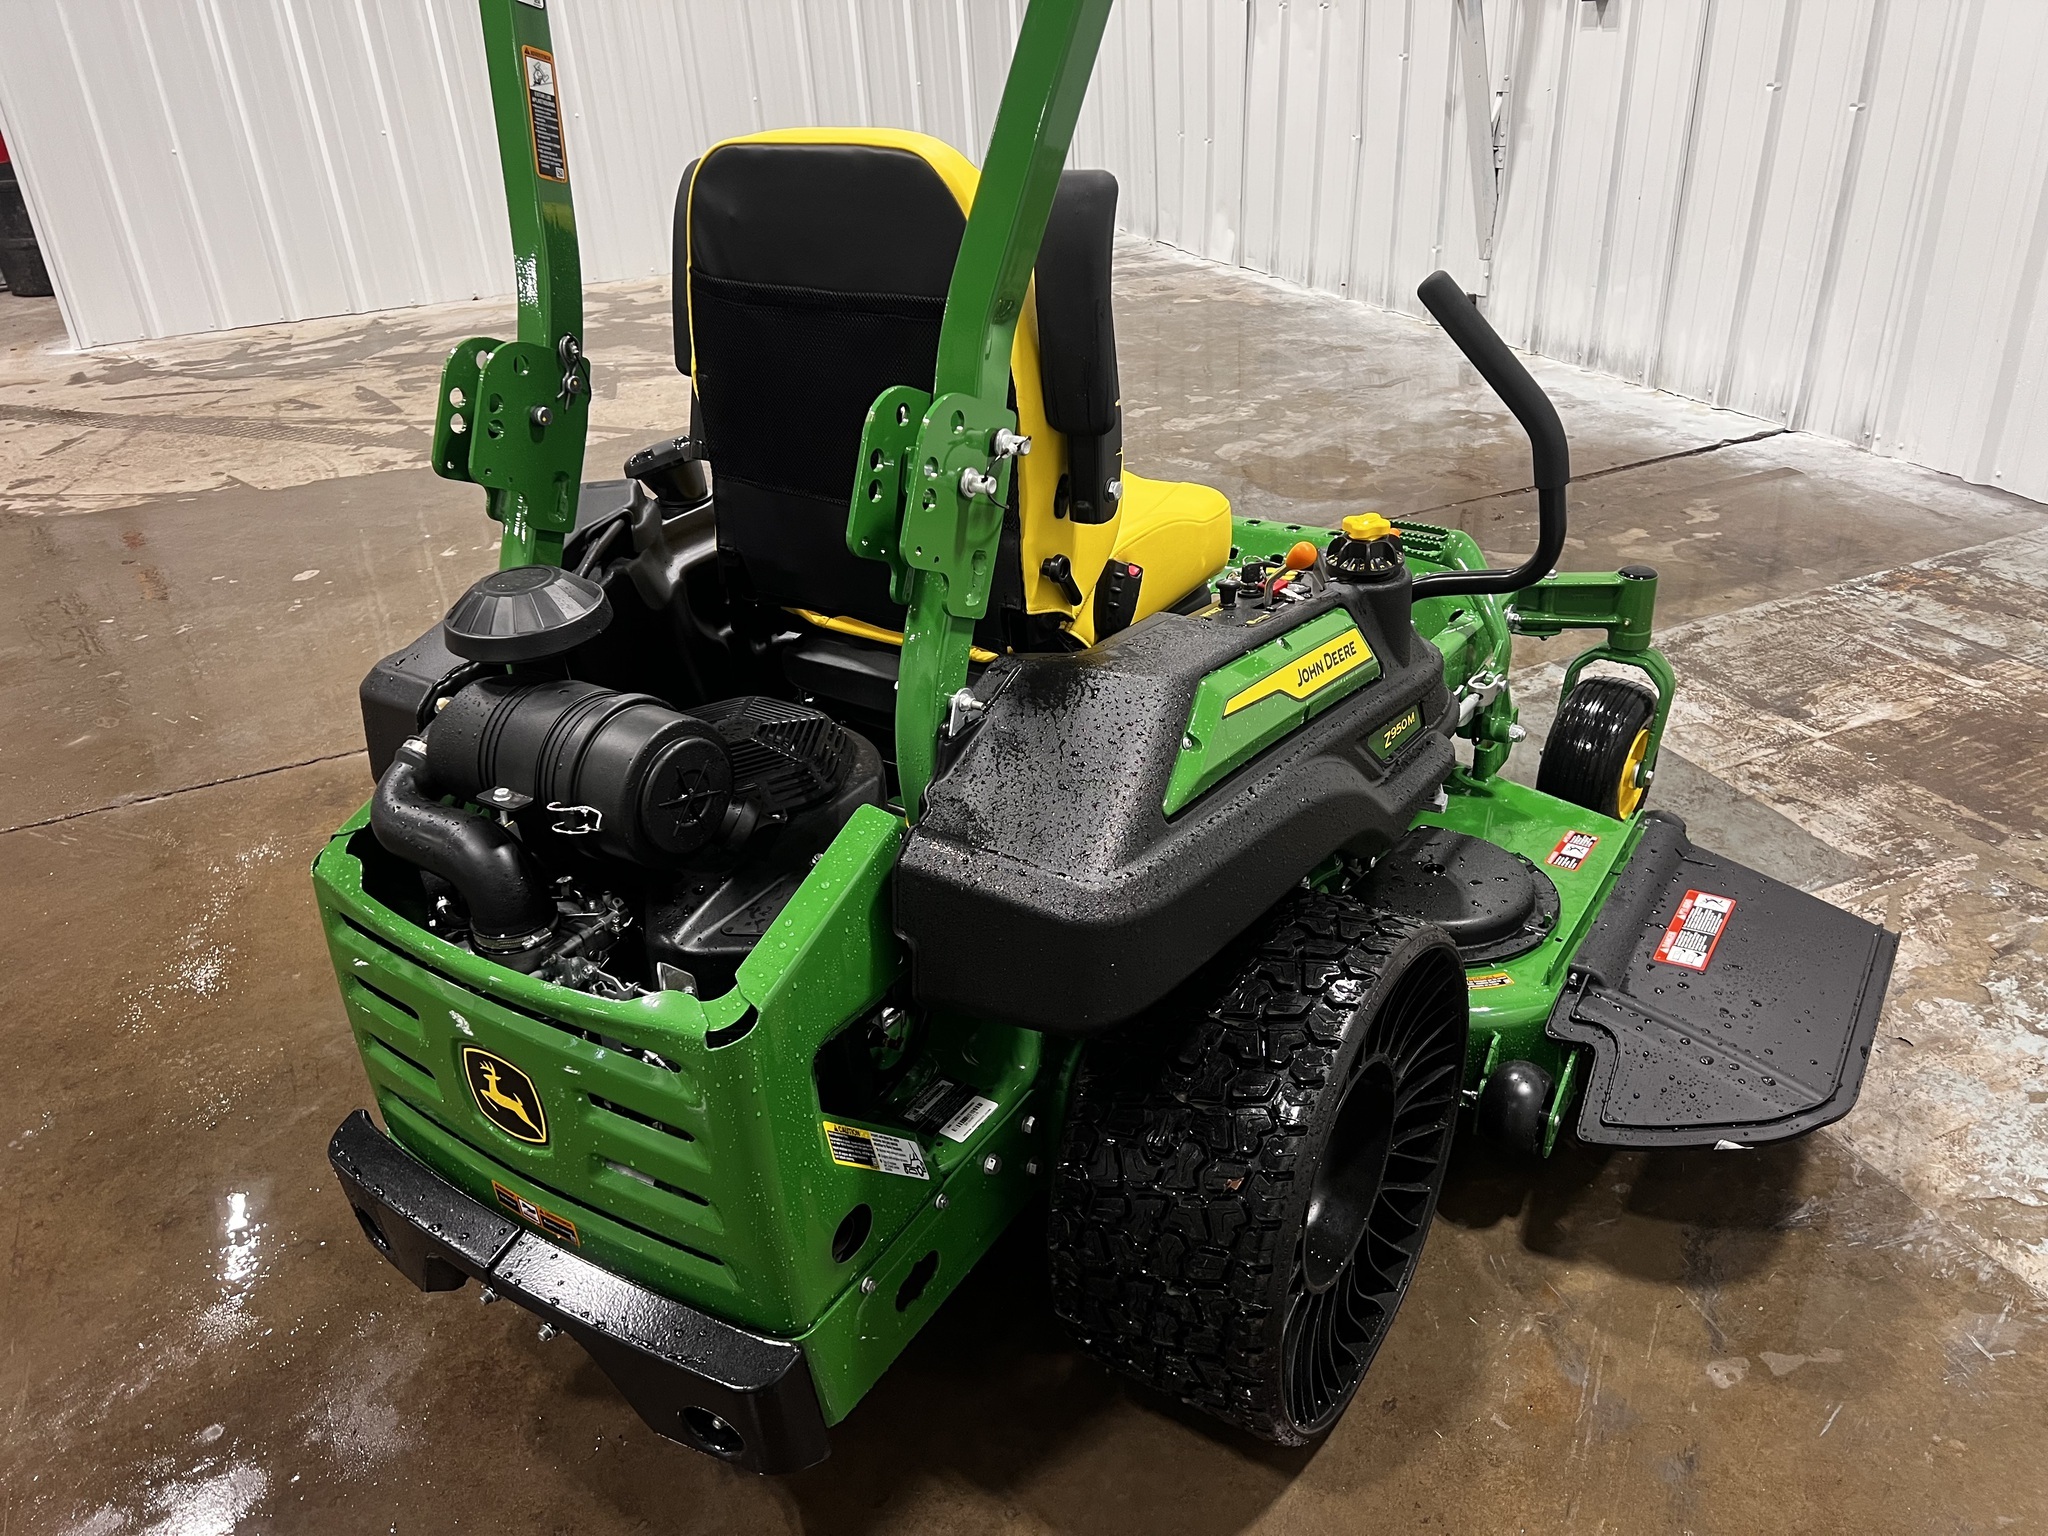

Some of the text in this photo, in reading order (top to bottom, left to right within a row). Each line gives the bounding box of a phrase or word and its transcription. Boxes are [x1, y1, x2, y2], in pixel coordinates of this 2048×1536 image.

[1297, 641, 1357, 688] JOHN DEERE
[1383, 711, 1416, 749] Z950M
